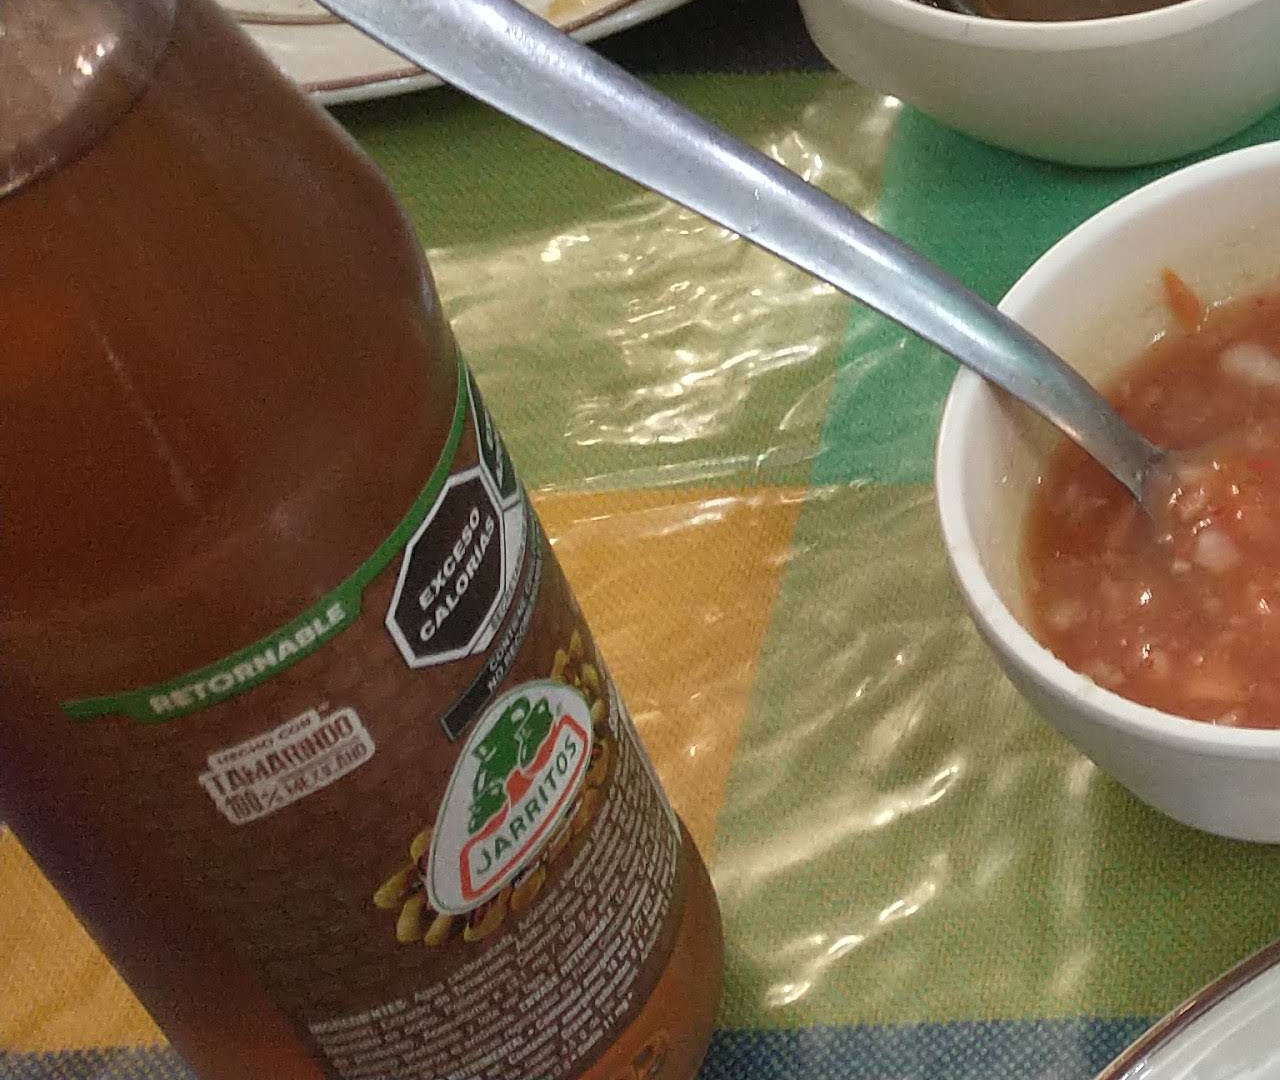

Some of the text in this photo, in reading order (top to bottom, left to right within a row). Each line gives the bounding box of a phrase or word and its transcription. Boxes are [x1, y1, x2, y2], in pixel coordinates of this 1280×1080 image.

[418, 506, 480, 611] EXCESO
[149, 602, 346, 714] RETORNABLE
[212, 715, 354, 796] TAMARINDO
[477, 734, 577, 875] JARRITOS
